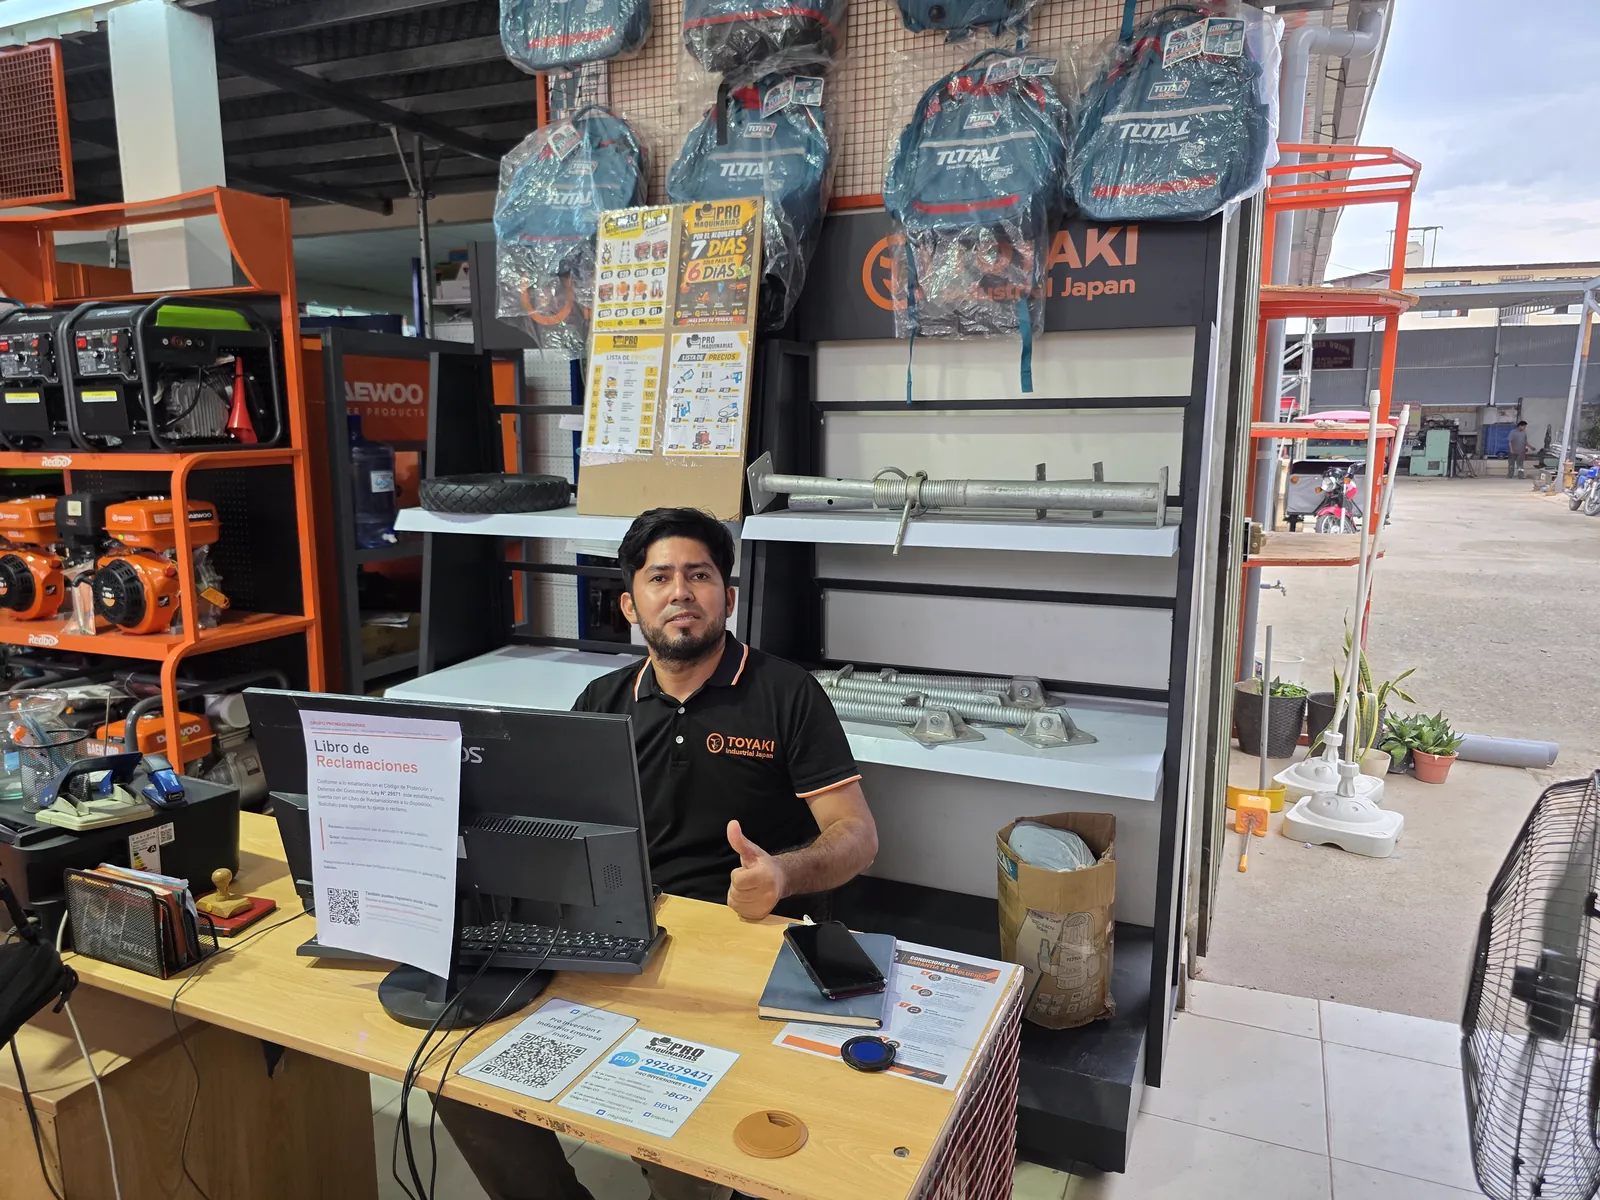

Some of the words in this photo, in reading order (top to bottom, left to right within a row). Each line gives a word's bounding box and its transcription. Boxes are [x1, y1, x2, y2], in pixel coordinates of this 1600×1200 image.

[1154, 84, 1184, 92] TOTAL
[968, 115, 994, 123] TOTAL
[1119, 120, 1191, 140] TOTAL
[937, 146, 1002, 166] TOTAL
[720, 161, 775, 177] TOTAL
[716, 204, 741, 220] PRO
[694, 219, 740, 229] MAQUINARIAS
[693, 232, 704, 241] POR
[704, 231, 711, 240] EL
[710, 230, 735, 239] ALQUILER
[691, 239, 707, 260] 7
[707, 236, 748, 258] DÍAS
[687, 262, 702, 282] 6
[702, 262, 736, 280] DÍAS
[1061, 278, 1136, 301] Japan
[624, 336, 639, 345] PRO
[708, 353, 736, 361] PRECIOS
[344, 381, 424, 405] AEWOO
[366, 407, 425, 417] PRODUCTS
[314, 739, 349, 754] Libro
[353, 742, 370, 755] de
[727, 736, 775, 752] TOYAKI
[725, 747, 755, 758] Industrial
[755, 750, 774, 760] Japan
[316, 755, 419, 774] Reclamaciones
[909, 955, 951, 968] CONDICIONES
[562, 1020, 596, 1033] Inversion
[569, 1029, 602, 1041] Empresa
[644, 1045, 699, 1062] MAQUINARIAS
[669, 1042, 705, 1058] PRO
[615, 1054, 637, 1065] plin
[645, 1058, 714, 1082] 992679471
[664, 1071, 680, 1080] PLIN
[646, 1073, 682, 1087] INVERSIONES
[668, 1091, 689, 1101] BCP
[654, 1101, 678, 1113] BBVA
